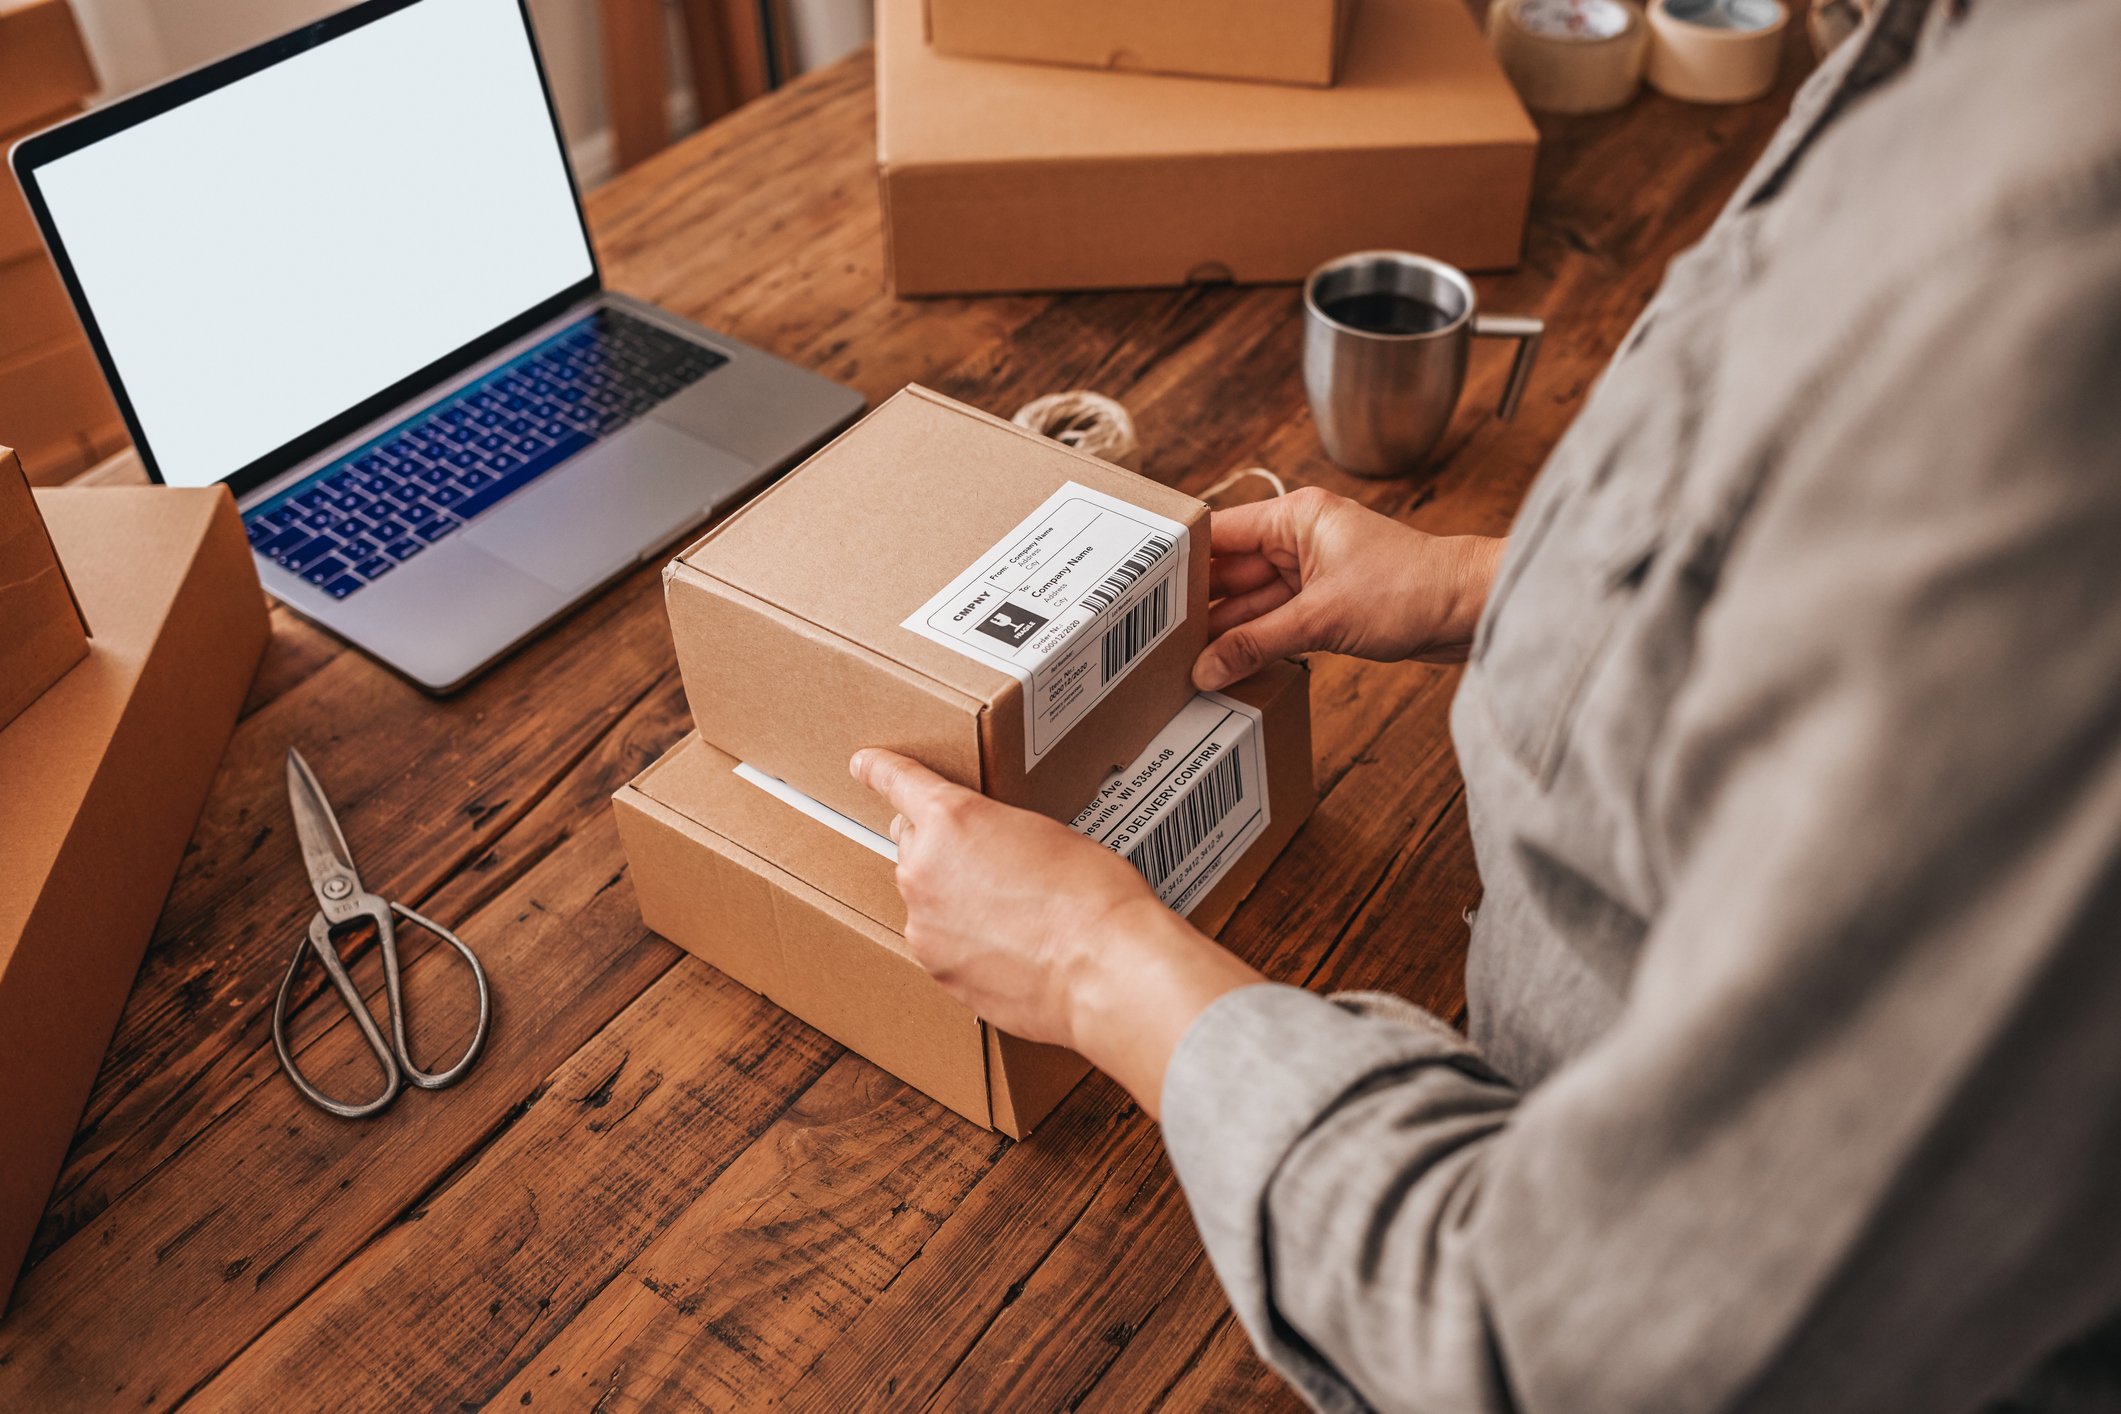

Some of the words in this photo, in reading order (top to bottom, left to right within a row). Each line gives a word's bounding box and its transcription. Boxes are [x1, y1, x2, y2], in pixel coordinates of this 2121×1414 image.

[990, 566, 1009, 580] From:
[1010, 542, 1038, 564] Company
[1035, 527, 1054, 542] Name
[1018, 548, 1041, 567] Address
[1025, 560, 1040, 570] City
[1032, 566, 1072, 598] Company
[1068, 546, 1094, 566] Name
[1019, 584, 1031, 593] To:
[1044, 583, 1068, 603] Address
[953, 591, 990, 622] CMPNY
[1054, 597, 1068, 607] City
[1014, 621, 1036, 639] FRAGILE
[1032, 632, 1052, 650] Order
[1041, 620, 1080, 654] 000012/2020
[1117, 787, 1135, 800] WI
[1132, 749, 1174, 787] 53545-08
[1126, 785, 1177, 834] DELIVERY
[1174, 742, 1222, 785] CONFIRM
[1070, 798, 1103, 827] Foster
[1101, 780, 1122, 798] Ave
